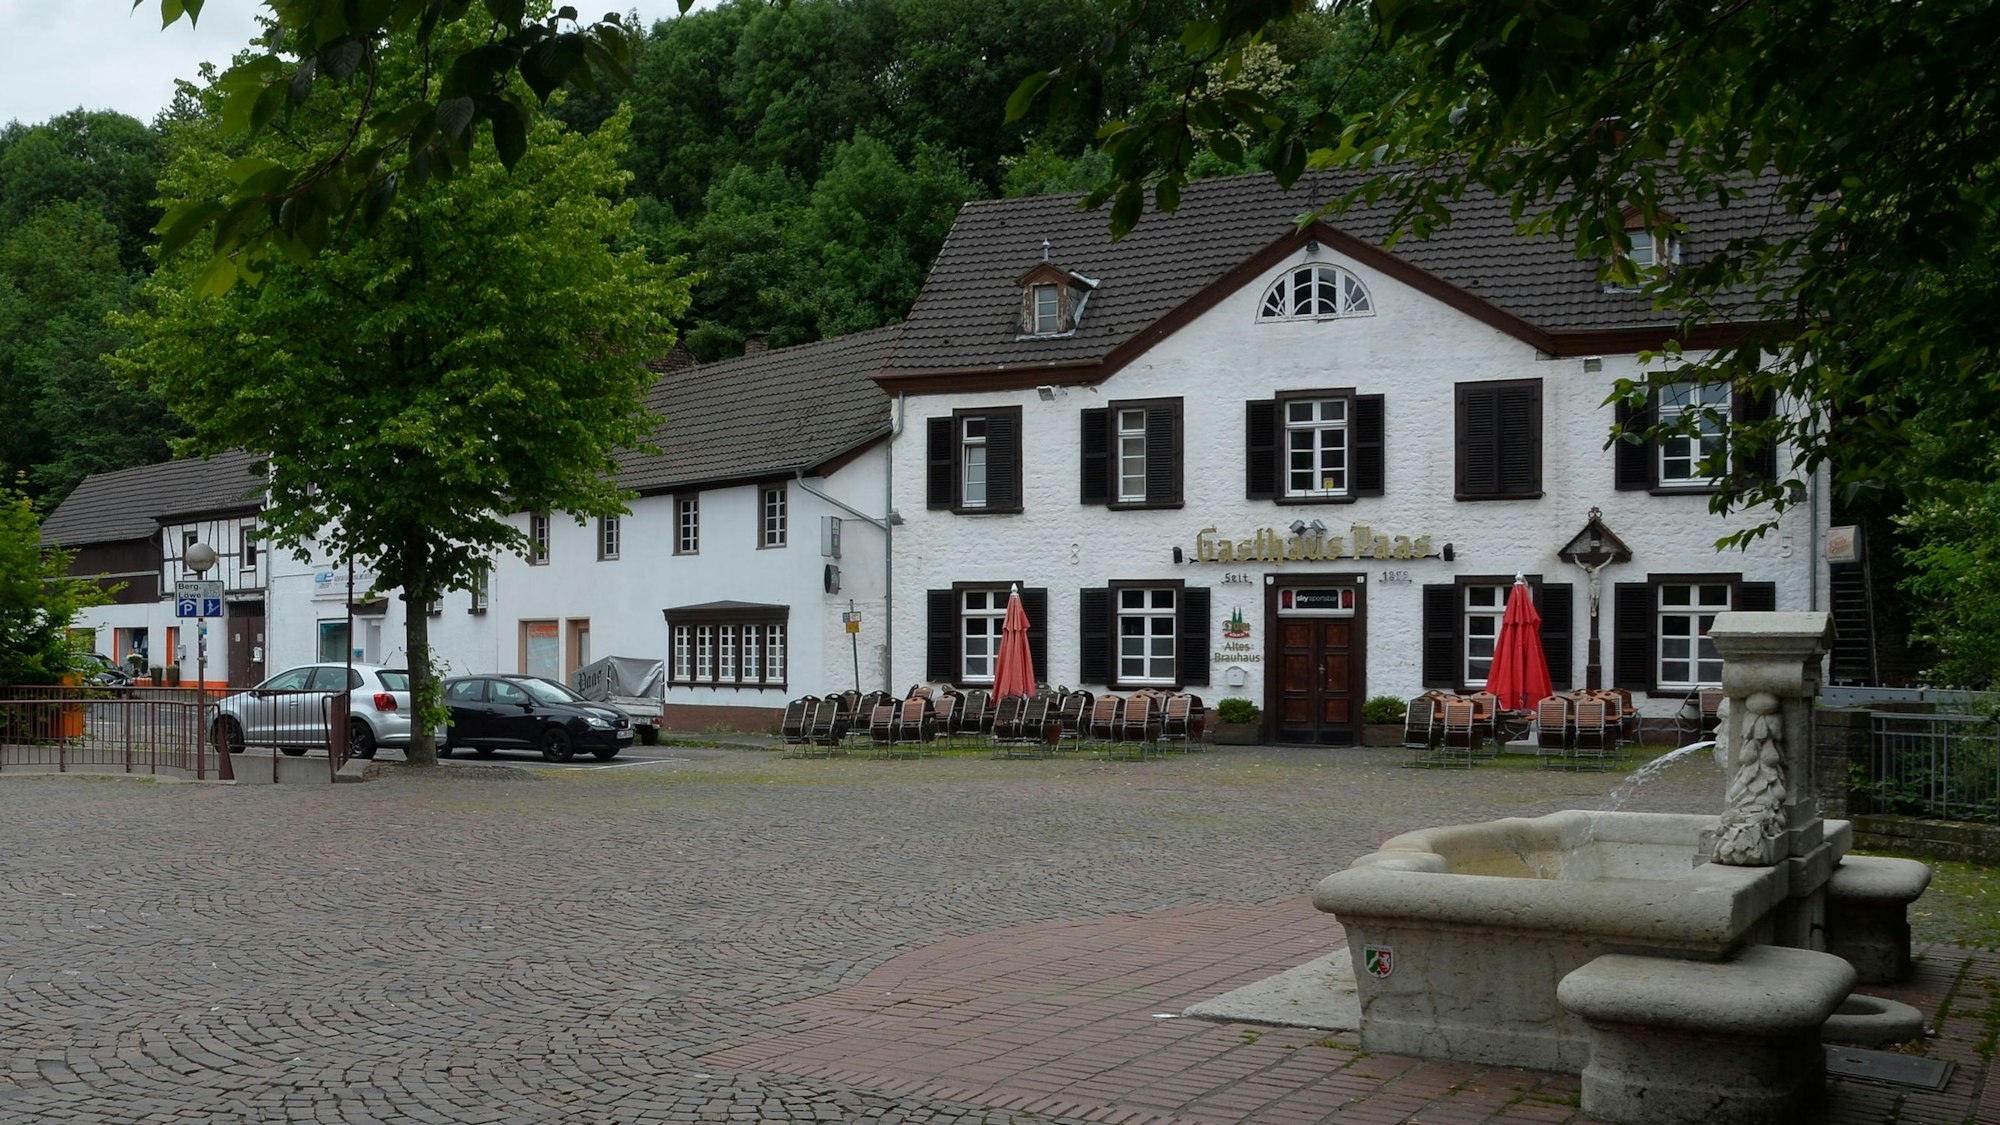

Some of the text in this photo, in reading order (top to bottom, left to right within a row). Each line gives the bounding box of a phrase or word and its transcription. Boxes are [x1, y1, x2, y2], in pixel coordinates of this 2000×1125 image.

[1197, 525, 1431, 565] Gasthaus Paas
[1225, 572, 1249, 583] Seit
[1296, 594, 1310, 603] sky
[183, 603, 193, 616] P
[1223, 641, 1251, 652] Altes
[1214, 652, 1261, 663] Brauhaus
[578, 670, 602, 692] Paas
